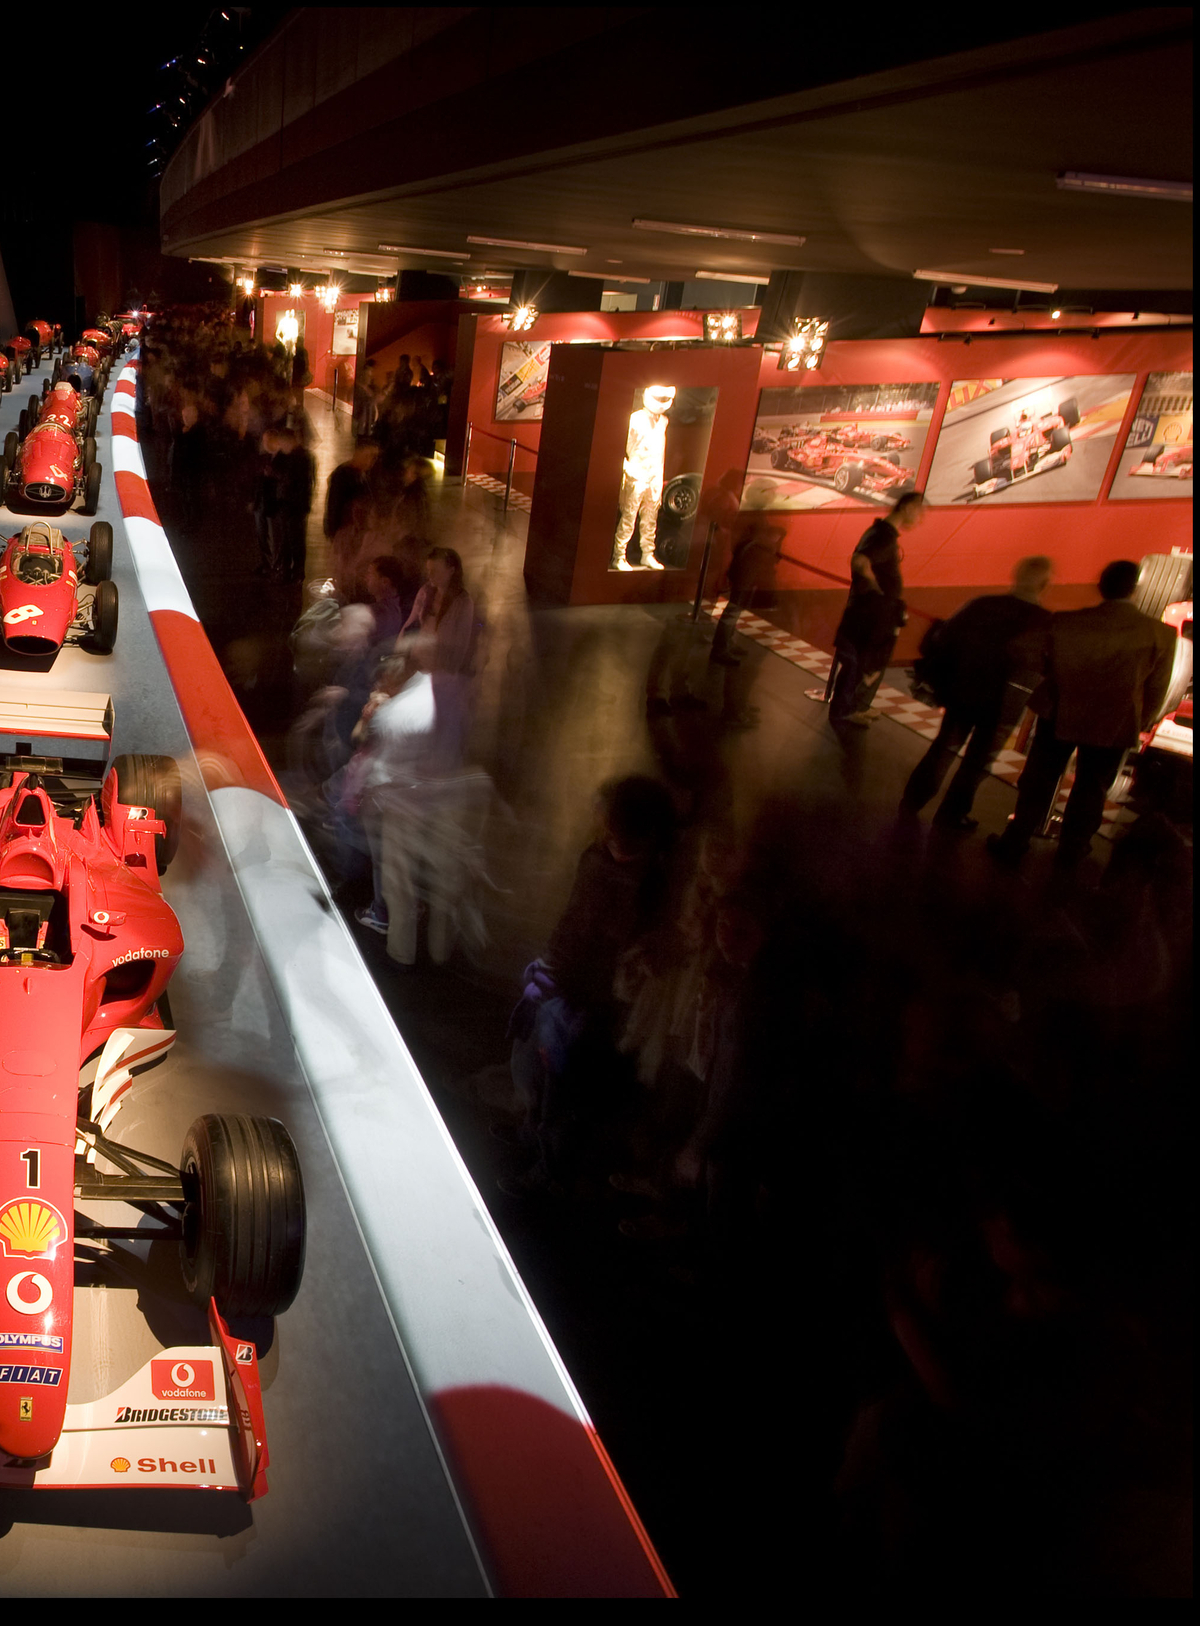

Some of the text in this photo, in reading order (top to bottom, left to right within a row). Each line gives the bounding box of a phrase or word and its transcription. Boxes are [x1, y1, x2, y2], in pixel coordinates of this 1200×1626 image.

[3, 604, 44, 624] 8
[111, 947, 170, 968] vodafone
[20, 1148, 40, 1189] 1
[0, 1367, 58, 1383] FIAT
[161, 1388, 207, 1398] vodafone
[114, 1406, 230, 1424] BRIDGESTONE
[137, 1458, 217, 1474] Shell
